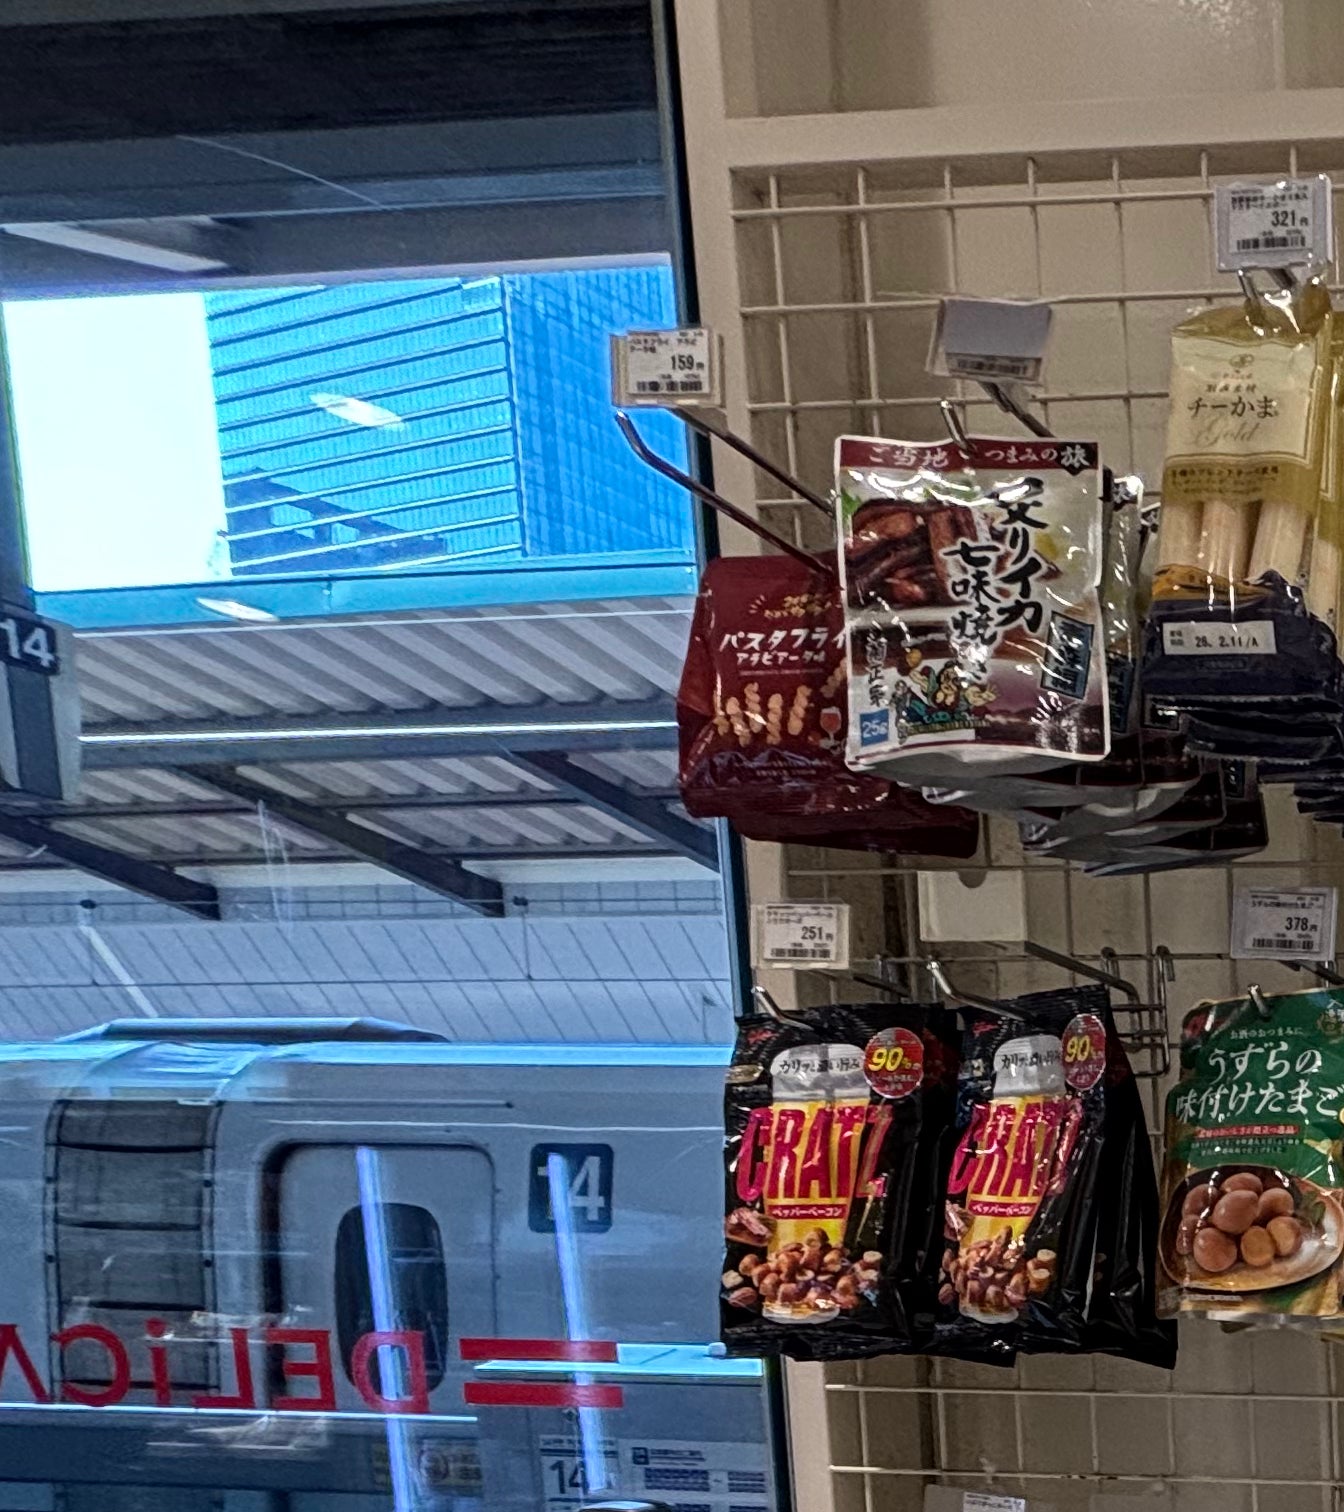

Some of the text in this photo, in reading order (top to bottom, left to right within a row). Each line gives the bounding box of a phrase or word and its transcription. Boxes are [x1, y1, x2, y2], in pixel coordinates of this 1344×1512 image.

[1188, 397, 1275, 418] チーかま
[869, 445, 1090, 470] ご当地 つまみの旅
[1208, 1041, 1323, 1085] うずらの
[736, 1104, 894, 1201] CRATZ
[772, 1206, 842, 1217] ペッパーベーコン
